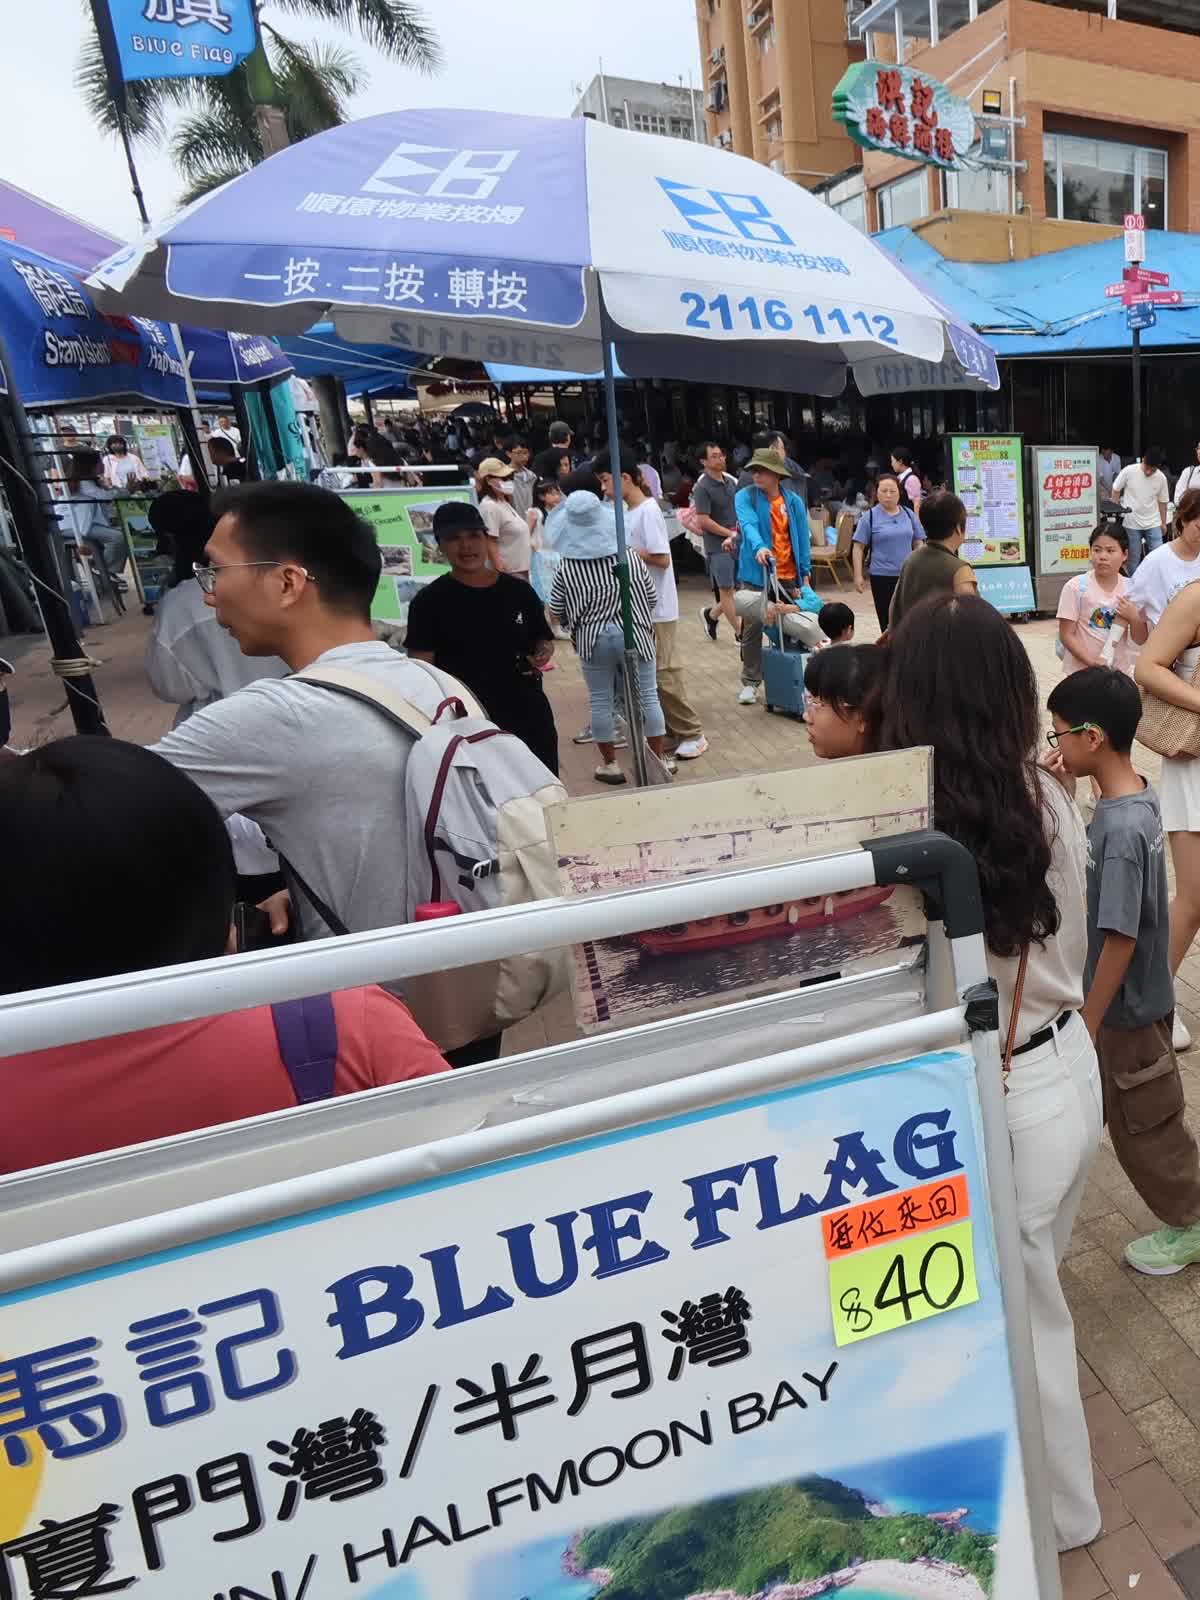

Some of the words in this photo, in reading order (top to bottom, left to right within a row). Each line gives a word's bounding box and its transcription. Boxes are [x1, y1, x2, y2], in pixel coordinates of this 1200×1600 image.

[679, 291, 793, 331] 2116
[802, 303, 898, 345] 1112
[0, 1288, 298, 1466] 馬記
[324, 1190, 671, 1360] BLUE
[684, 1108, 965, 1250] FLAG
[839, 1241, 965, 1333] $40
[343, 1409, 713, 1583] HALFMOON
[728, 1361, 840, 1434] BAY
